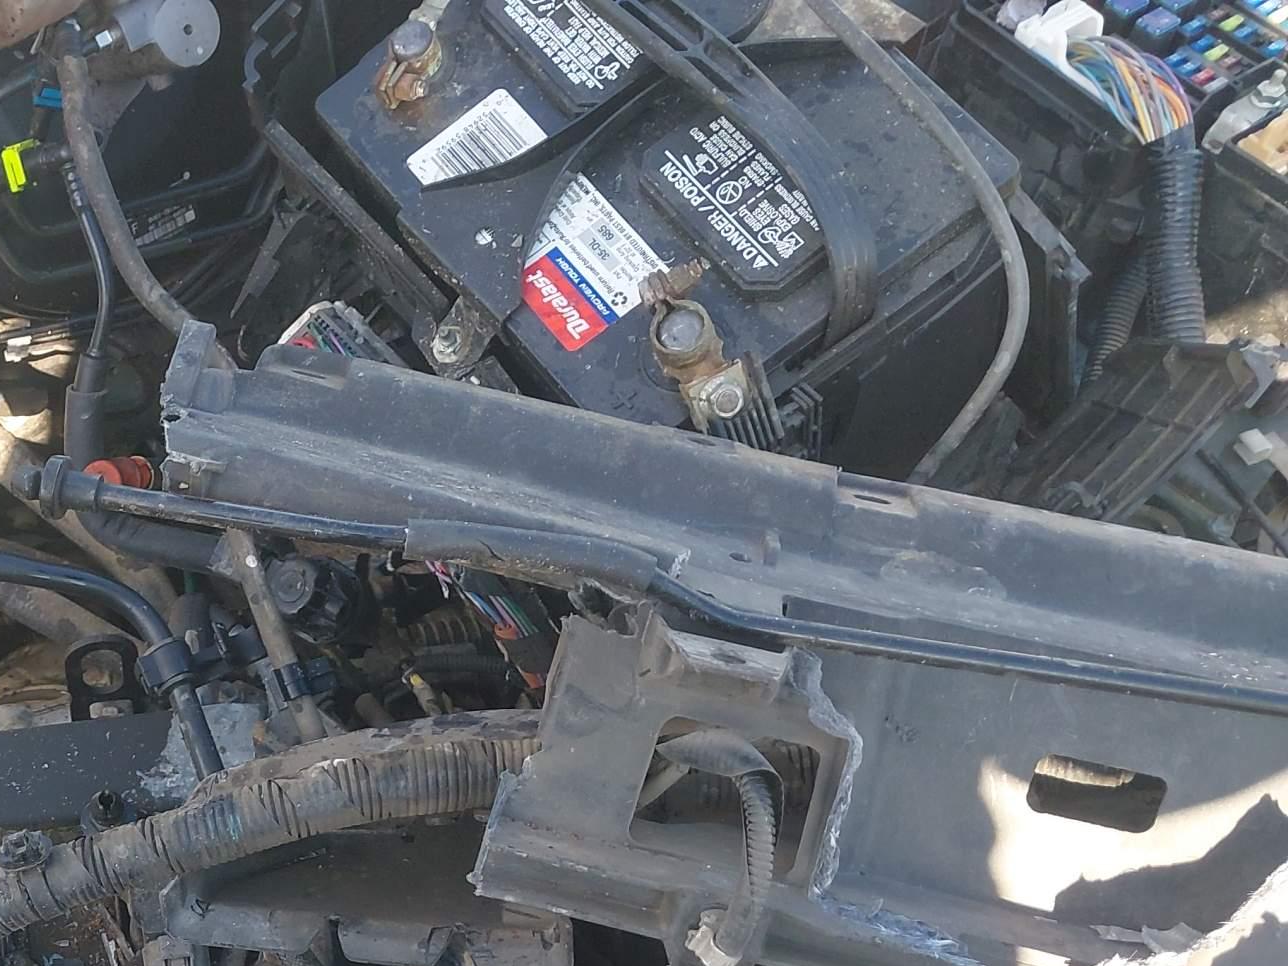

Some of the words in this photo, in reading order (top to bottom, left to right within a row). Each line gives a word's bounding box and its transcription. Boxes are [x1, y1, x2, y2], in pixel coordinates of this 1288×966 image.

[688, 125, 707, 144] ACID
[700, 138, 732, 169] SULFURIC
[658, 160, 706, 207] POISON
[736, 174, 753, 190] NO
[737, 207, 763, 232] SHIELD
[751, 206, 771, 225] EYES
[758, 197, 792, 232] EXPLOSIVE
[777, 202, 801, 225] GASES
[597, 223, 615, 242] 685
[611, 219, 626, 234] BEST
[706, 209, 758, 260] DANGER
[587, 237, 610, 261] 35-DL
[554, 254, 581, 283] TOUGH
[526, 270, 590, 340] Duralast
[577, 281, 611, 316] PROVEN
